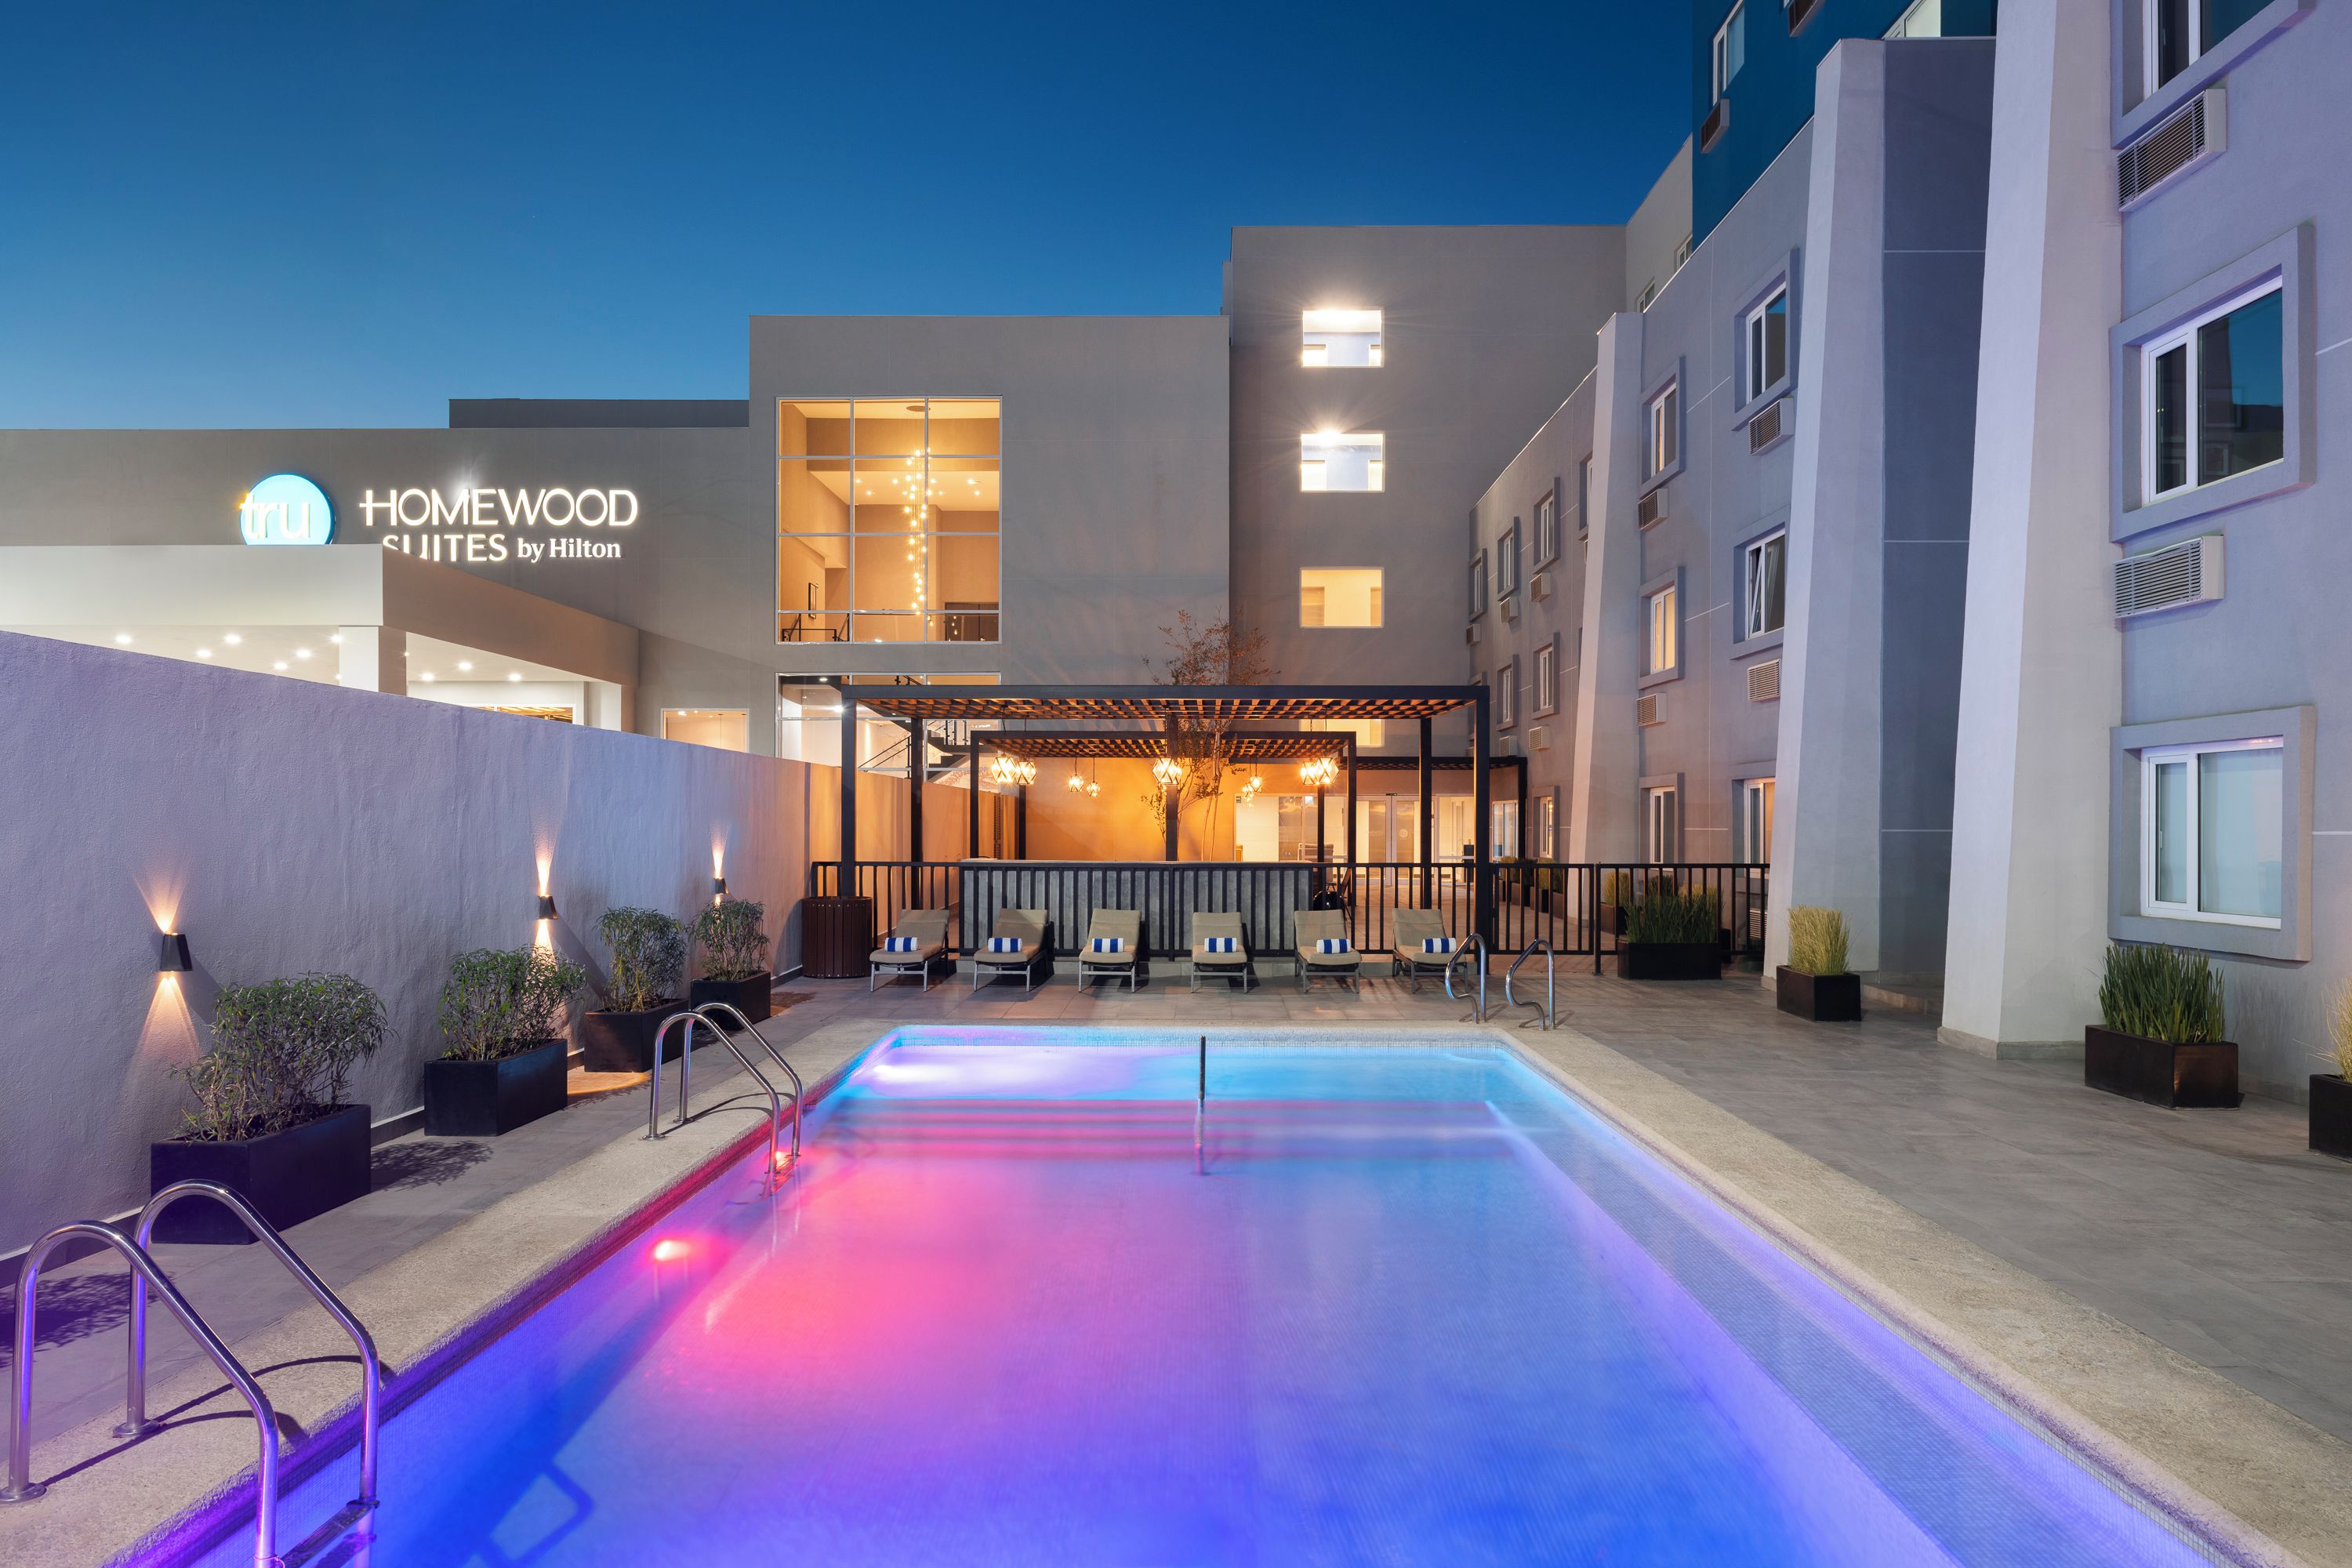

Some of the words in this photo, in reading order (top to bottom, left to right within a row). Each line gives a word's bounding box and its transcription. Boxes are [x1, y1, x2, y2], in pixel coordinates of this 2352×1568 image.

[239, 492, 310, 539] tru
[359, 488, 638, 527] HOMEWOOD
[517, 537, 546, 564] by
[549, 537, 622, 559] Hilton
